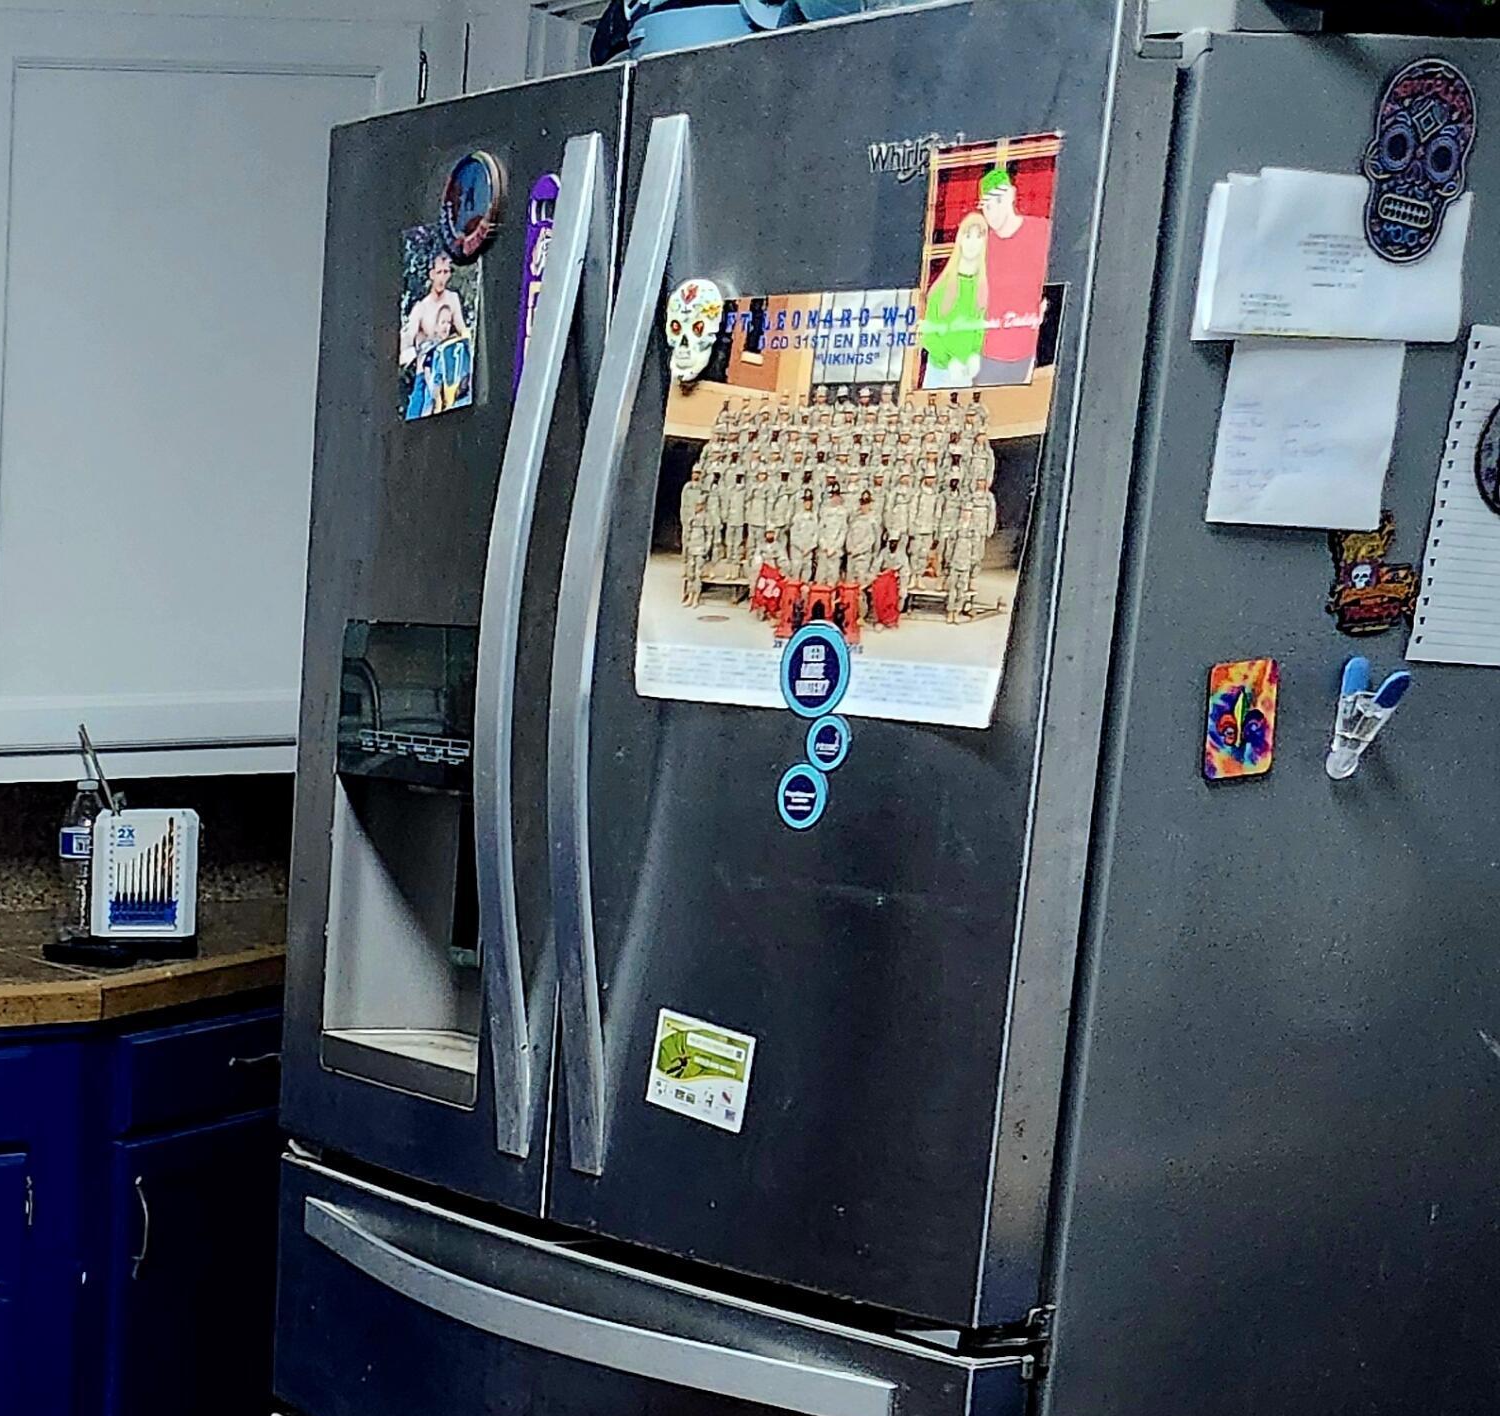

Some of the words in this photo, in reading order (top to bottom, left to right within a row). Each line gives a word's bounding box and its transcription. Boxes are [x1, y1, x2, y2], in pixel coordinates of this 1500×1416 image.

[868, 132, 964, 183] Whirlp
[882, 305, 916, 328] WO
[794, 333, 828, 350] 31ST
[834, 333, 854, 348] EN
[859, 332, 881, 347] BN
[118, 828, 135, 839] 2X
